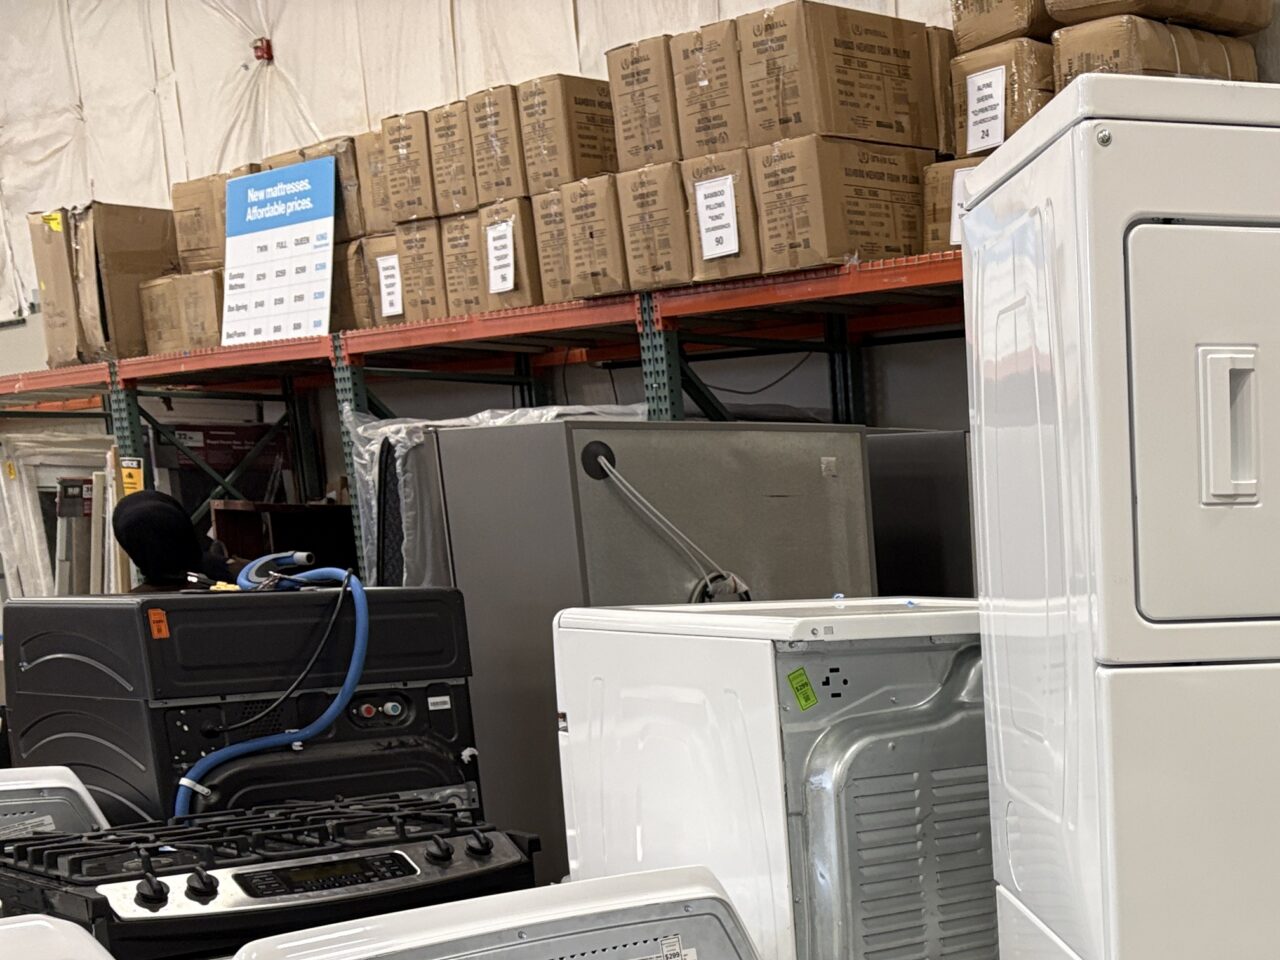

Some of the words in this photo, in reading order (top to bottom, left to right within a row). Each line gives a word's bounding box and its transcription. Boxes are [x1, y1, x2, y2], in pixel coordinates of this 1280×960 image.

[981, 129, 989, 139] 24
[248, 186, 266, 203] New
[704, 190, 725, 200] BAMBOO
[246, 199, 287, 222] Affordable
[715, 236, 724, 246] 90
